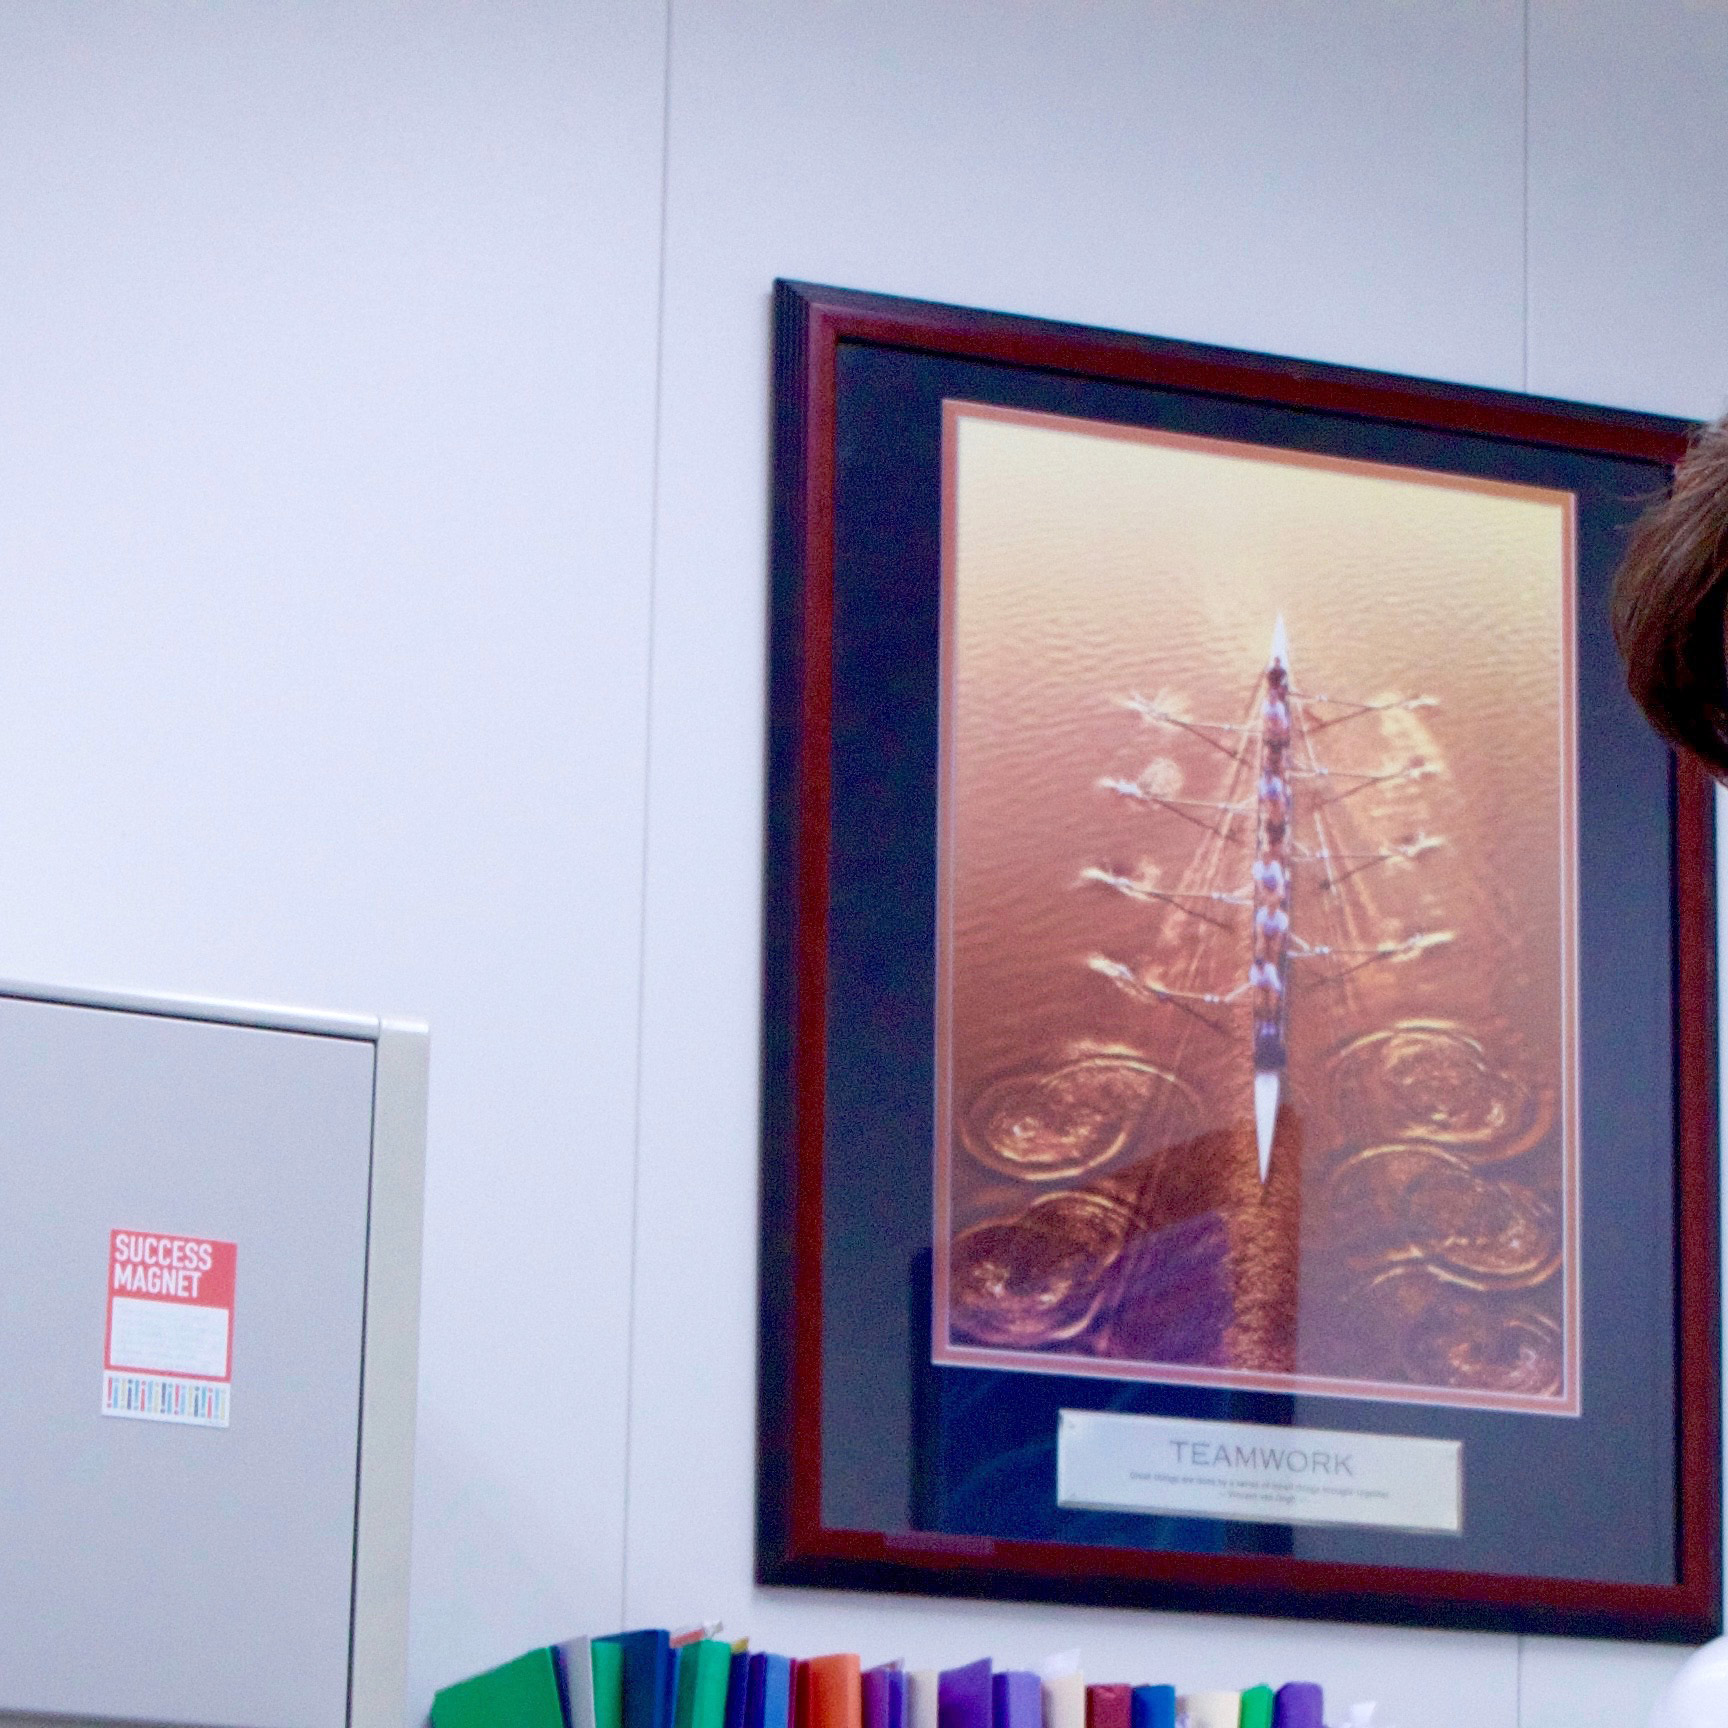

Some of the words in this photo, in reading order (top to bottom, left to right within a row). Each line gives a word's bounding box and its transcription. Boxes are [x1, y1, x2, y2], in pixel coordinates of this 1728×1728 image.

[114, 1233, 213, 1271] SUCCESS
[113, 1263, 202, 1298] MAGNET
[1170, 1440, 1353, 1477] TEAMWORK
